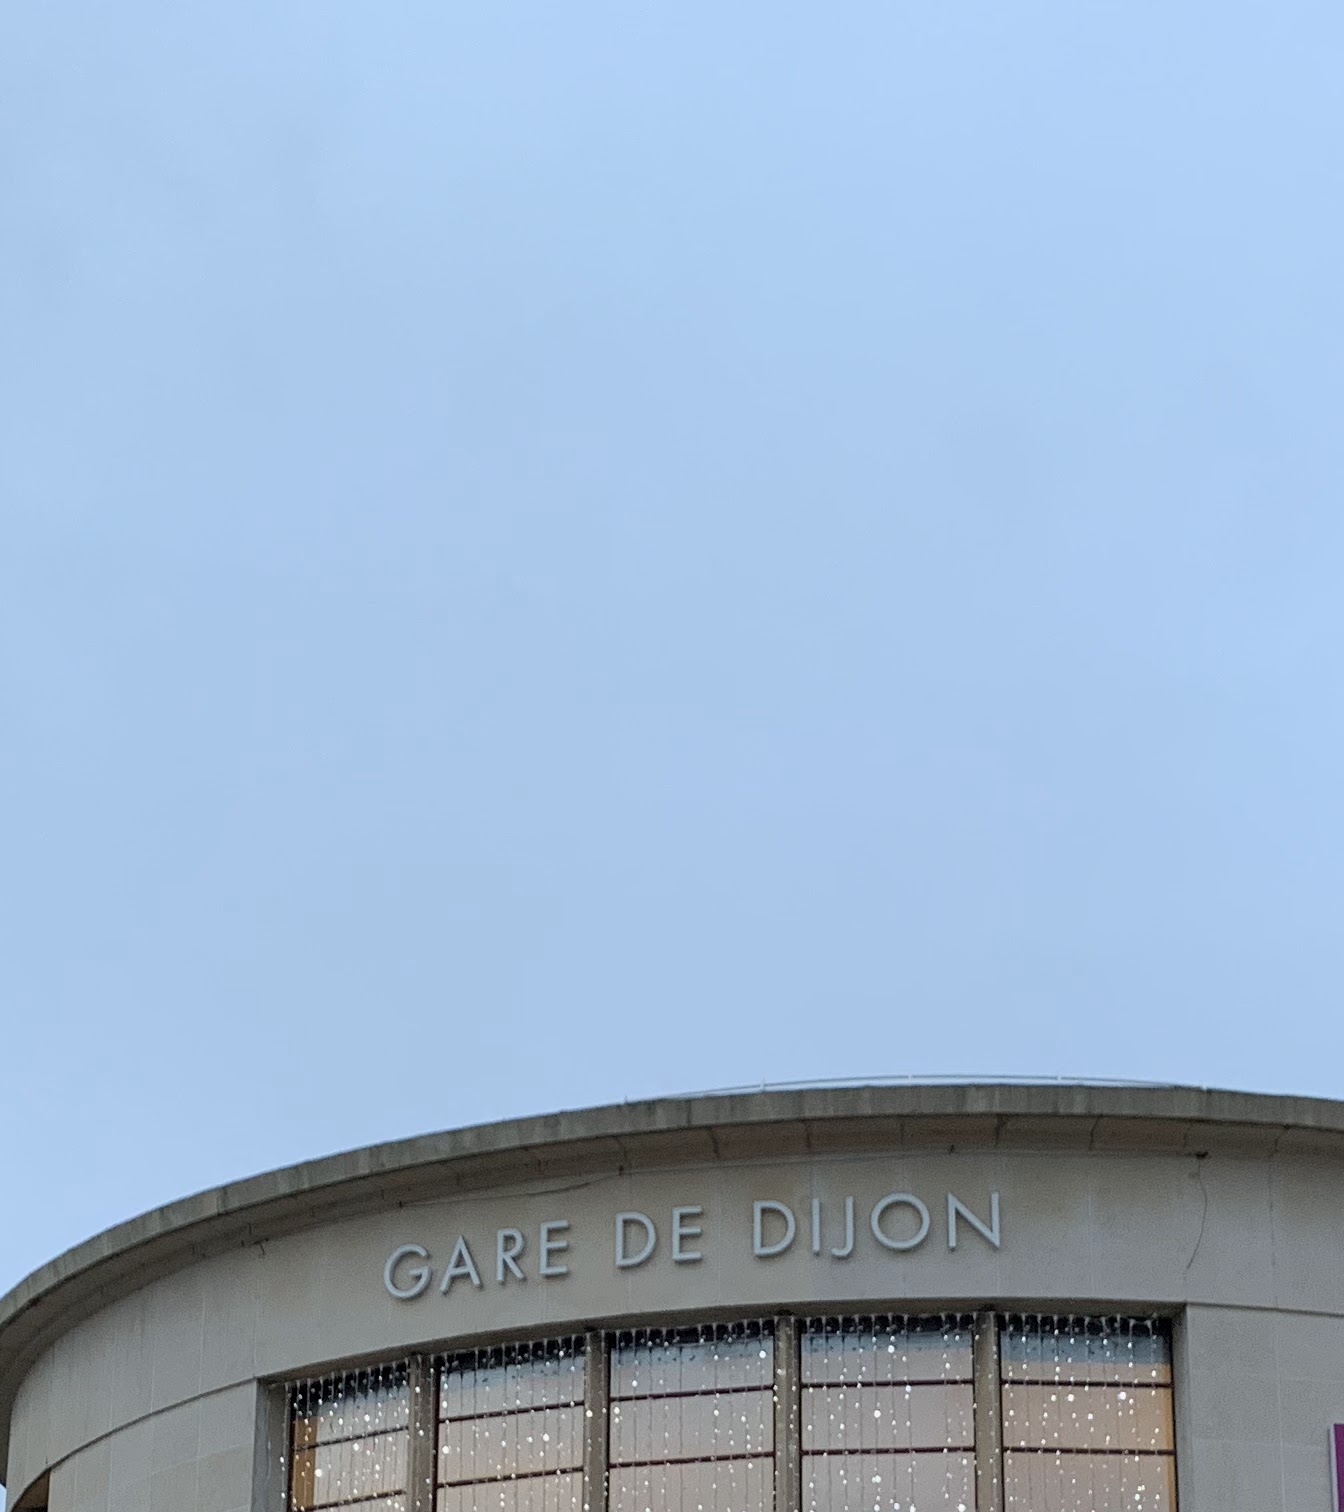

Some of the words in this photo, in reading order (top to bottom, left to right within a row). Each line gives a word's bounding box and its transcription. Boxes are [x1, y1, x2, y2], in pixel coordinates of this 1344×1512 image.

[383, 1220, 571, 1300] GARE
[615, 1205, 704, 1269] DE
[753, 1192, 1002, 1259] DIJON
